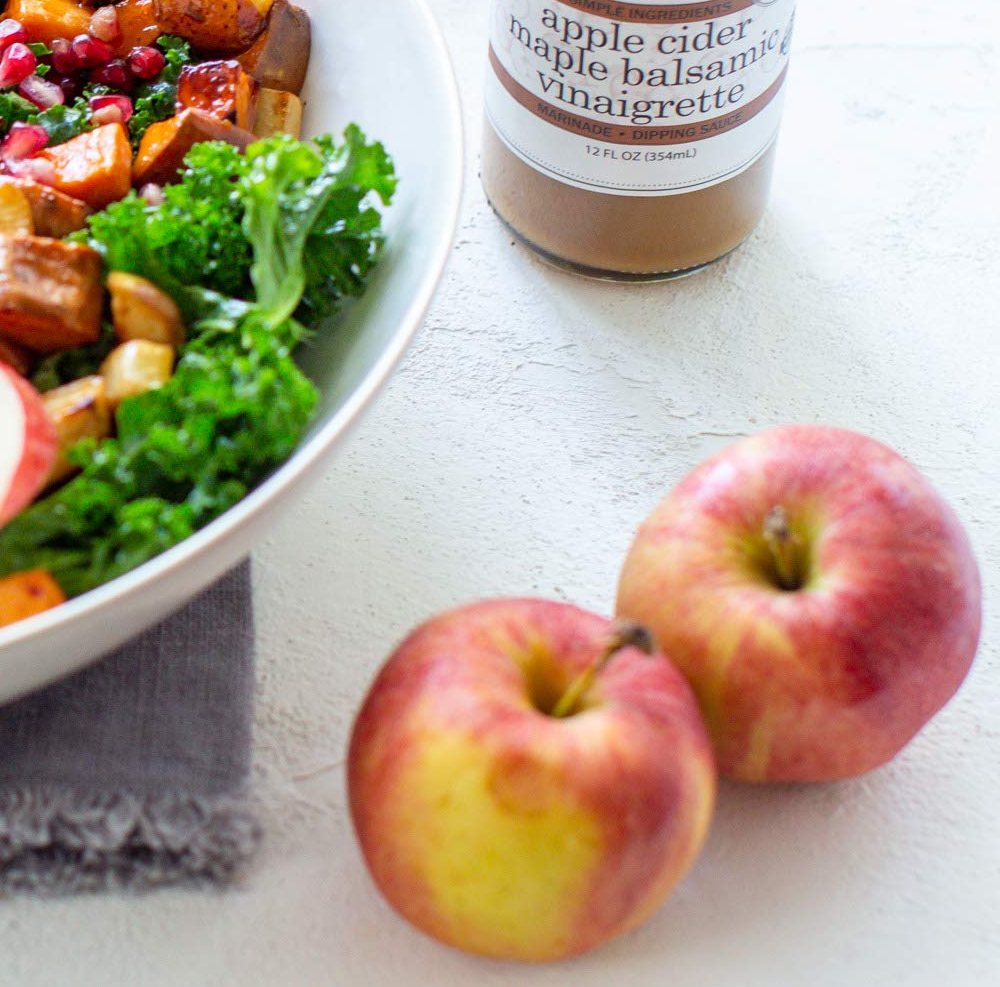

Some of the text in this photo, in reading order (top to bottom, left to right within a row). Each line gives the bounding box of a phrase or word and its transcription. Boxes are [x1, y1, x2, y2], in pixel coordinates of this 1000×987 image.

[541, 8, 752, 55] apple cider
[629, 1, 733, 21] INGREDIENTS
[509, 14, 779, 88] maple balsamic
[536, 69, 745, 126] vinaigrette
[537, 102, 743, 141] MARINADE DIPPING SAUCE
[585, 145, 697, 163] 12 FL OZ (354mL)
